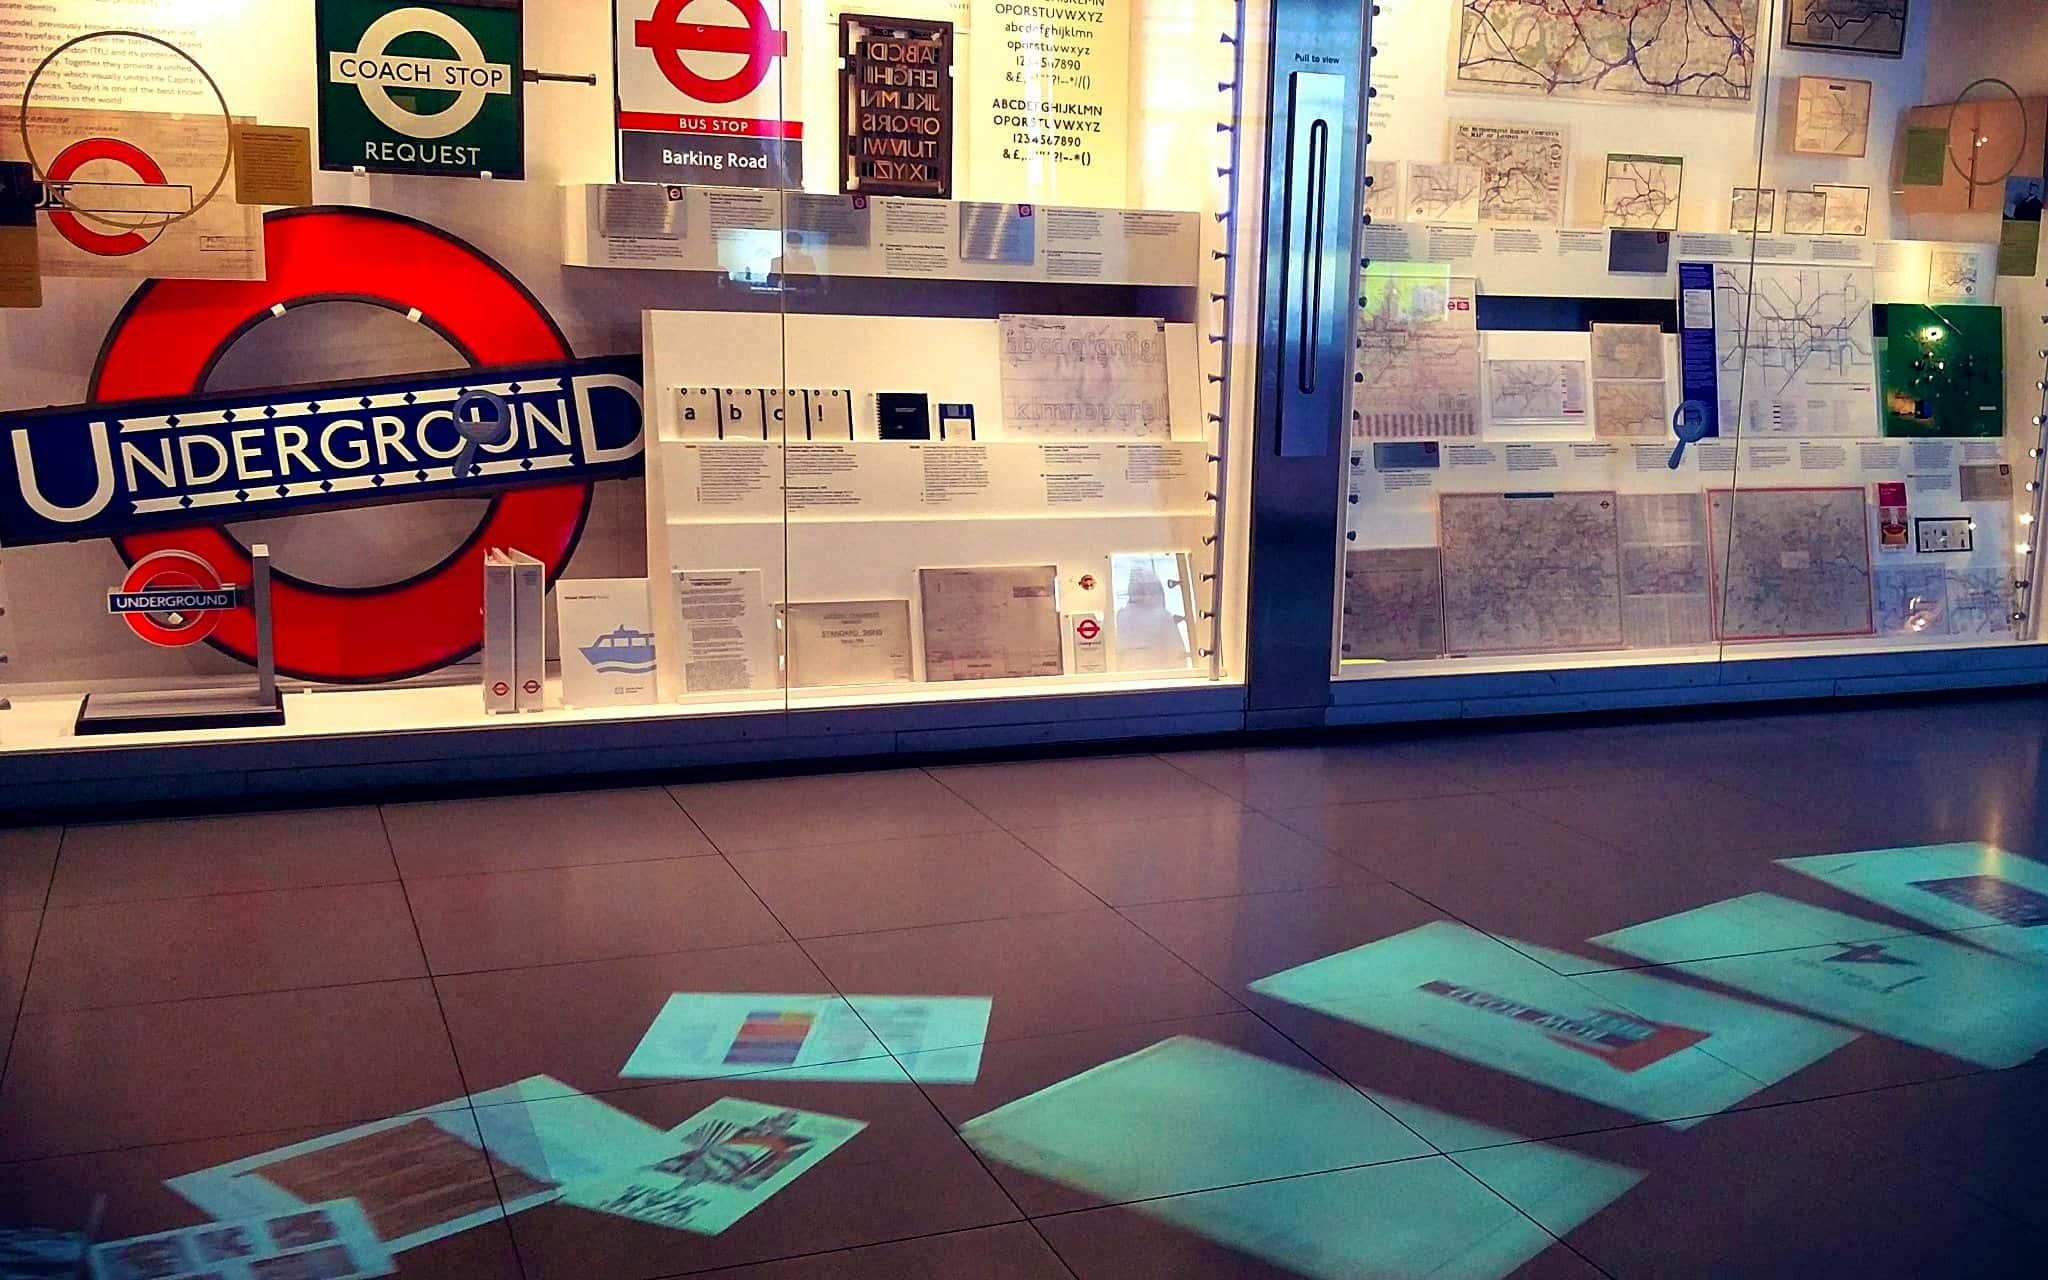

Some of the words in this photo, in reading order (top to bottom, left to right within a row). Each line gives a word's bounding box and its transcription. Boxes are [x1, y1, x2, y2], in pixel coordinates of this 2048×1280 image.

[1295, 52, 1310, 62] Pull
[1311, 55, 1321, 63] to
[1322, 56, 1341, 64] view
[339, 58, 431, 83] COACH
[445, 66, 503, 88] STOP
[679, 118, 707, 131] BUS
[712, 120, 749, 132] STOP
[1013, 133, 1081, 147] 1234567890
[365, 141, 481, 166] REQUEST
[662, 149, 724, 170] Barking
[727, 152, 768, 169] Road
[684, 407, 696, 421] a
[730, 403, 742, 421] b
[11, 373, 644, 523] UNDERGROUND
[116, 594, 228, 609] UNDERGROUND
